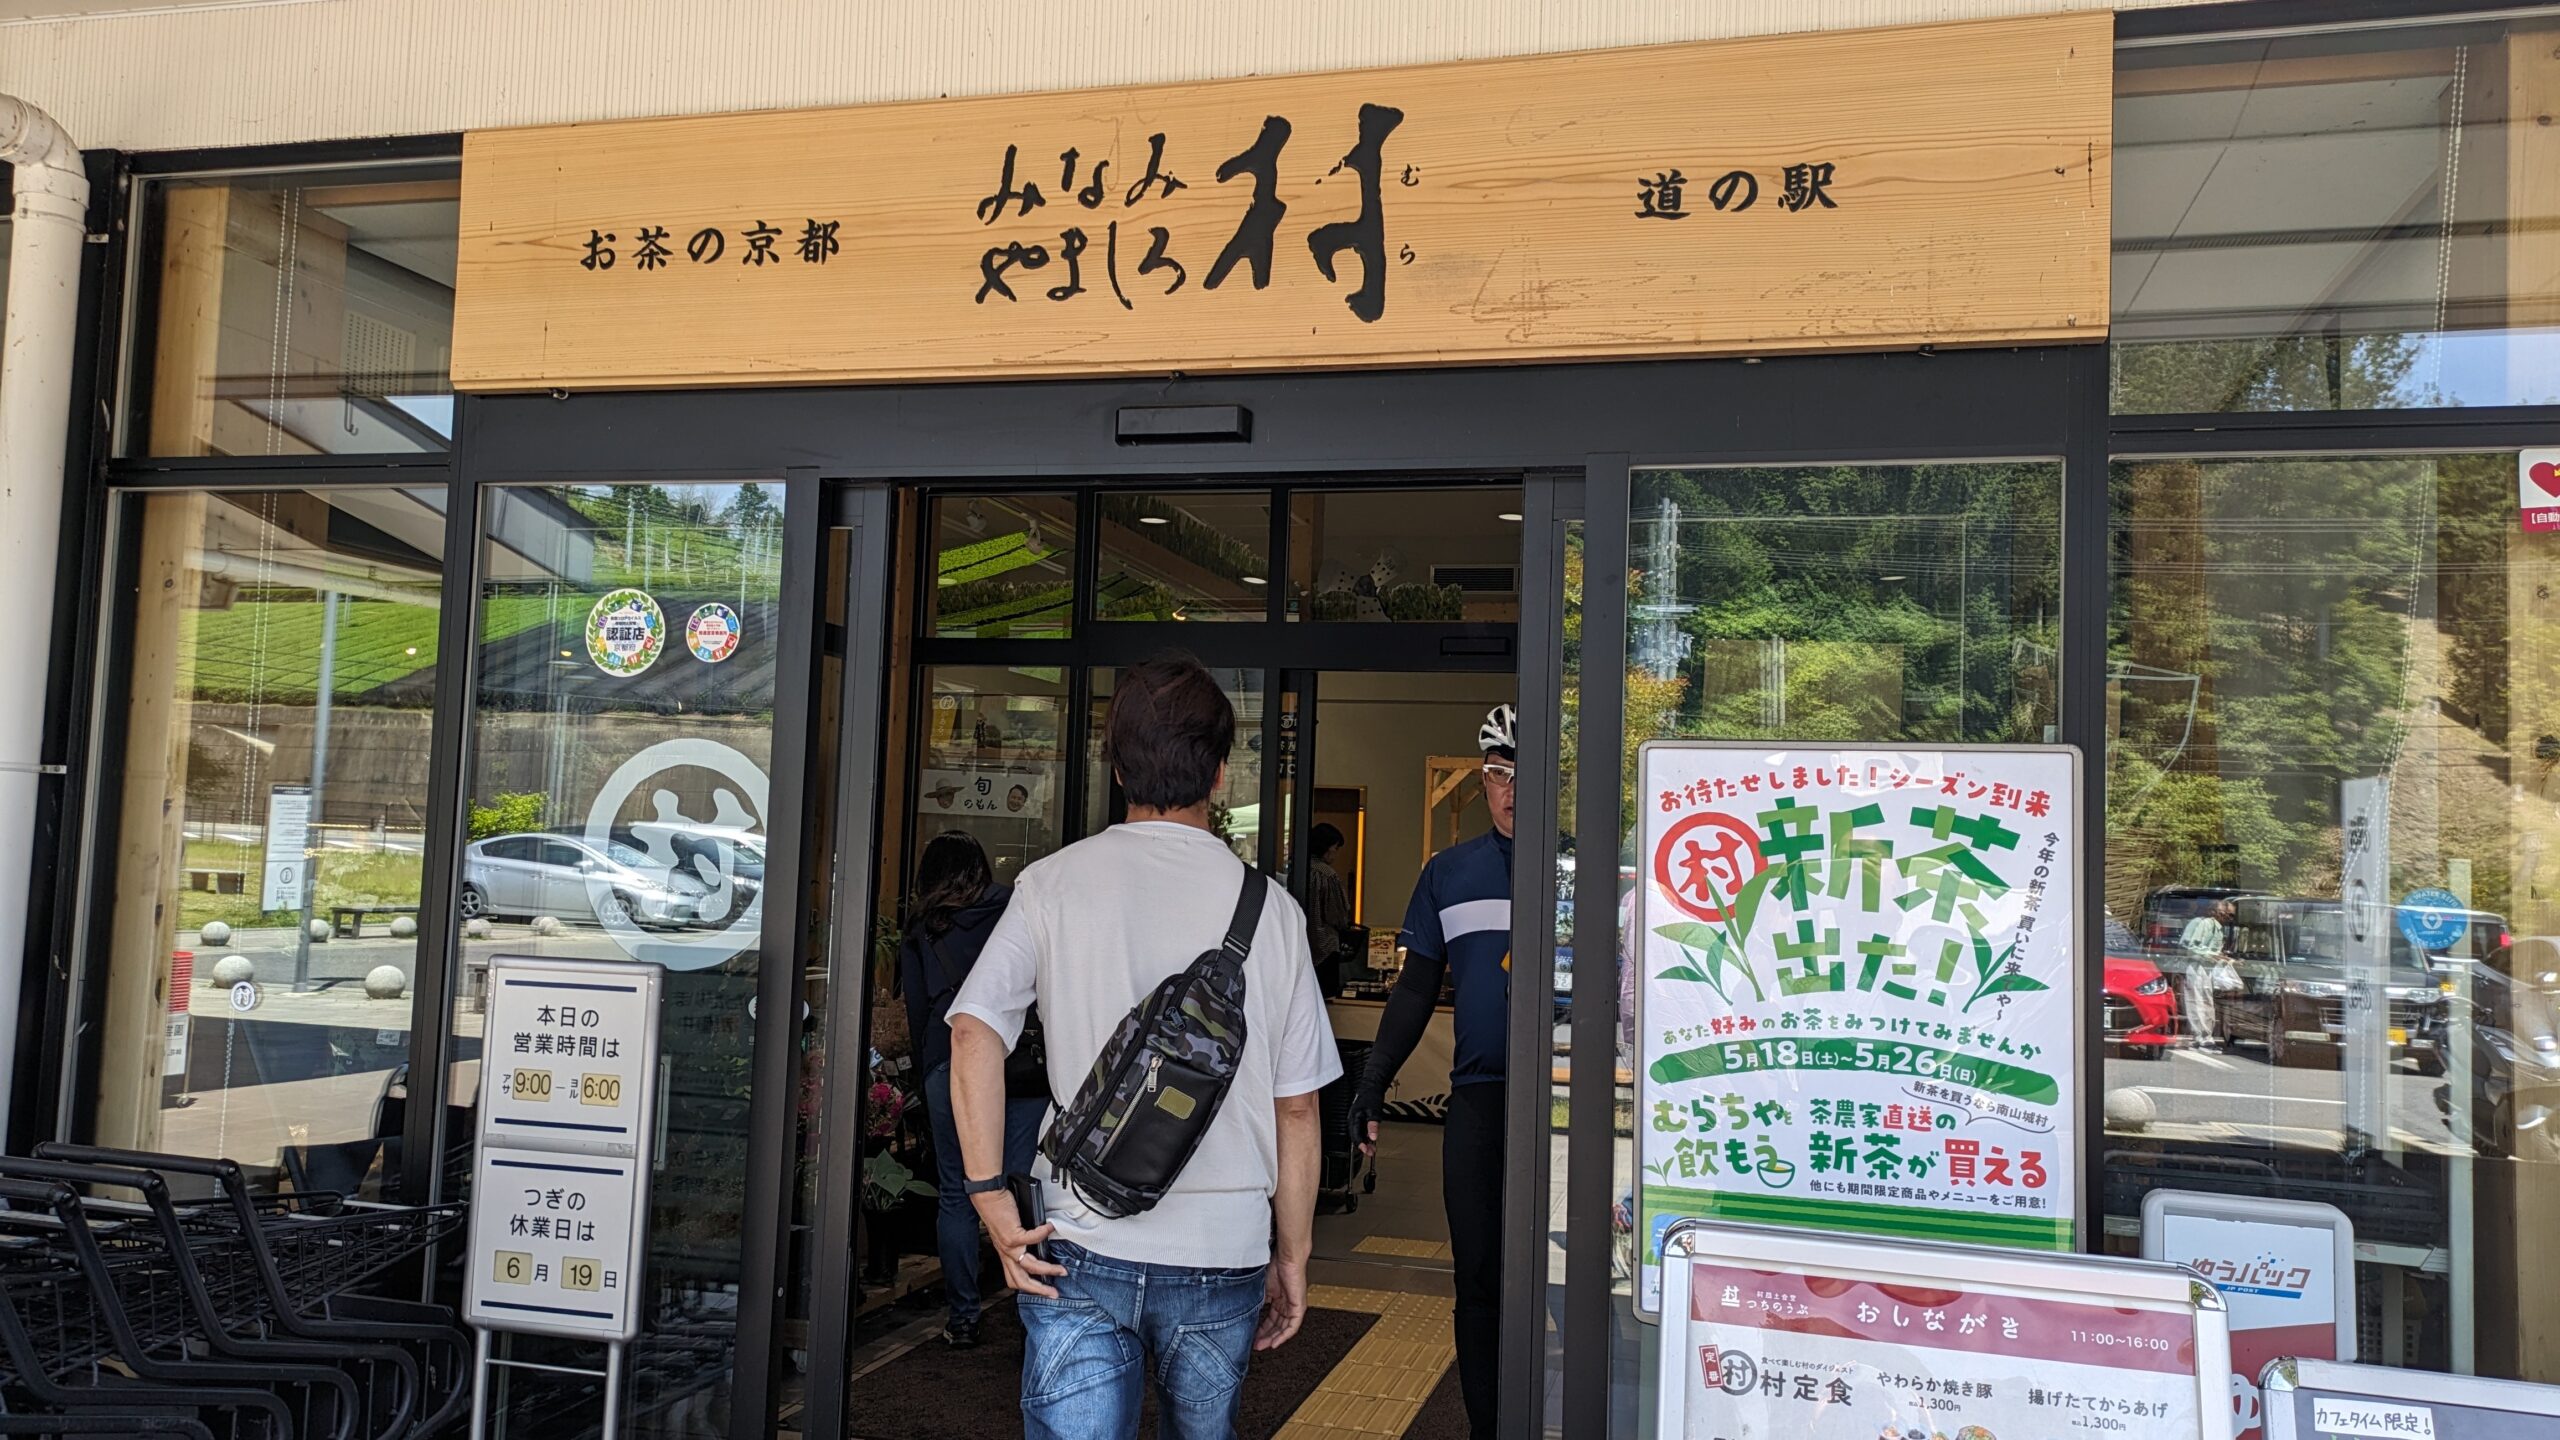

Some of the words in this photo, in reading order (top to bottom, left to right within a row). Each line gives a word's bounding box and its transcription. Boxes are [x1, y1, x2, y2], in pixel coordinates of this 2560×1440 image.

[976, 132, 1188, 225] みなみ
[1634, 162, 1839, 220] 道の駅
[1203, 103, 1404, 323] 村
[579, 218, 840, 271] お茶の京都
[975, 221, 1187, 310] やましろ
[606, 627, 645, 641] 認証店
[974, 776, 992, 796] 旬
[964, 799, 997, 810] のもん
[1679, 831, 1743, 902] 村
[1756, 796, 2021, 930] 新茶
[1772, 919, 1964, 1007] 出た!
[536, 1004, 600, 1028] 本日の
[513, 1032, 621, 1060] 営業時間は
[502, 1073, 511, 1094] アサ
[515, 1071, 552, 1096] 9:00
[569, 1078, 579, 1100] ヨル
[583, 1076, 621, 1101] 6:00
[1808, 1098, 1957, 1132] 茶農家直送の
[1913, 1080, 2049, 1128] 新茶を買うなら南山城村
[1673, 1135, 1778, 1178] 飲もう
[1808, 1130, 2048, 1189] 新茶が買える
[524, 1188, 586, 1212] つぎの
[509, 1214, 596, 1242] 休業日は
[2191, 1258, 2311, 1290] ゆうパック
[2237, 1286, 2260, 1294] POST
[1746, 1300, 1810, 1316] つちのうぶ
[1856, 1301, 2020, 1340] おしながき
[1704, 1350, 1720, 1383] 定番
[1759, 1369, 1854, 1407] 村定食
[1876, 1370, 1994, 1400] やわらか焼き豚
[2027, 1387, 2169, 1419] 揚げたてからあげ
